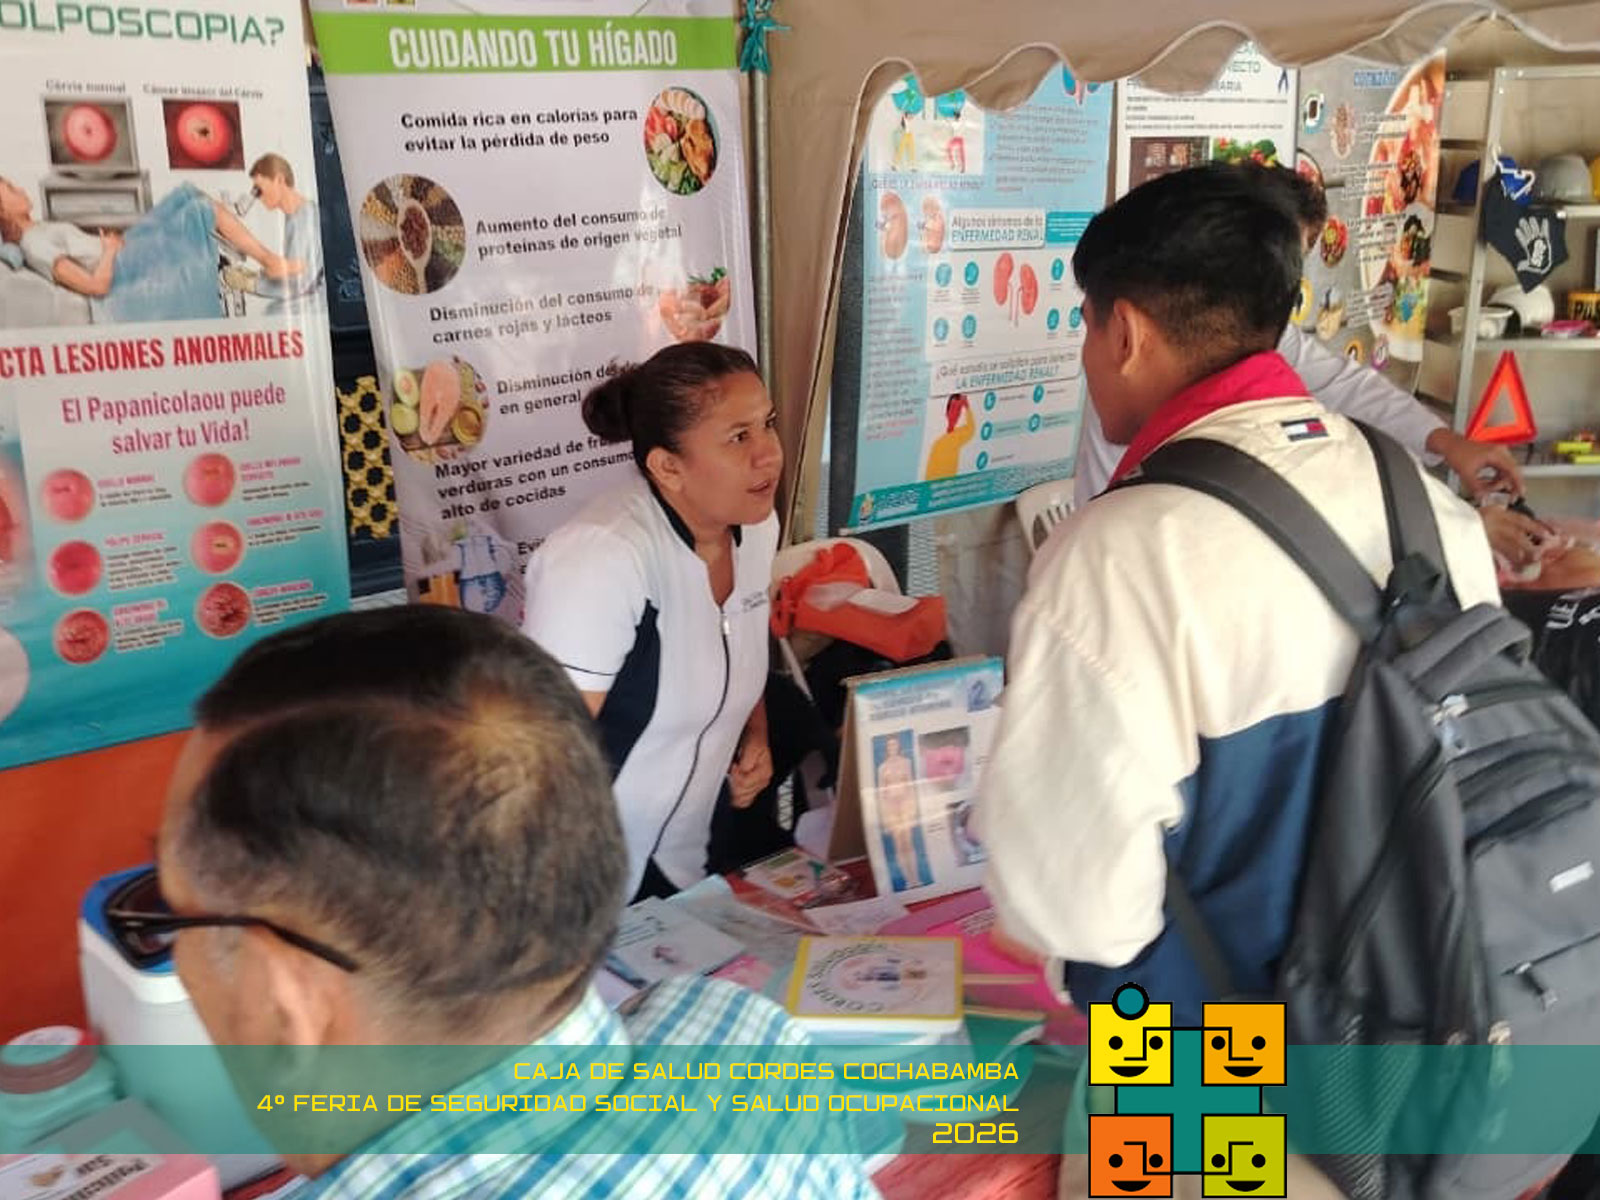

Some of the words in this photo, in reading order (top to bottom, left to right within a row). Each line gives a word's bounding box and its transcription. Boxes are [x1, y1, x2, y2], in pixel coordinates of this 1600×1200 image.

[388, 26, 538, 68] CUIDANDO
[543, 28, 581, 66] TU
[588, 22, 678, 67] HÍGADO
[401, 111, 468, 129] Comida
[472, 110, 506, 127] rica
[510, 112, 532, 126] en
[536, 108, 599, 125] calorías
[603, 109, 639, 126] para
[404, 134, 456, 152] evitar
[461, 133, 476, 150] la
[481, 131, 545, 155] pérdida
[550, 130, 568, 146] de
[573, 131, 610, 150] peso
[476, 217, 548, 235] Aumento
[553, 213, 577, 230] del
[581, 209, 647, 227] consumo
[477, 238, 556, 261] proteínas
[560, 235, 579, 251] de
[583, 231, 630, 251] origen
[633, 226, 682, 247] vegetal
[429, 297, 534, 322] Disminución
[539, 293, 563, 310] del
[567, 288, 633, 306] consumo
[432, 325, 493, 345] carnes
[497, 319, 539, 339] rojas
[543, 318, 553, 335] y
[556, 309, 613, 330] lácteos
[0, 347, 46, 379] CTA
[51, 338, 165, 375] LESIONES
[172, 330, 305, 366] ANORMALES
[496, 367, 593, 394] Disminución
[61, 397, 82, 424] El
[87, 388, 222, 427] Papanicolaou
[230, 381, 287, 414] puede
[499, 401, 520, 415] en
[524, 389, 582, 415] general
[112, 427, 173, 454] salvar
[177, 424, 197, 448] tu
[200, 418, 251, 445] Vida!
[435, 459, 488, 481] Mayor
[492, 444, 562, 468] variedad
[566, 440, 584, 455] de
[437, 477, 513, 499] verduras
[518, 470, 547, 485] con
[551, 464, 569, 478] un
[573, 451, 635, 472] consumo
[441, 502, 475, 520] alto
[479, 498, 500, 514] de
[504, 484, 567, 507] cocidas
